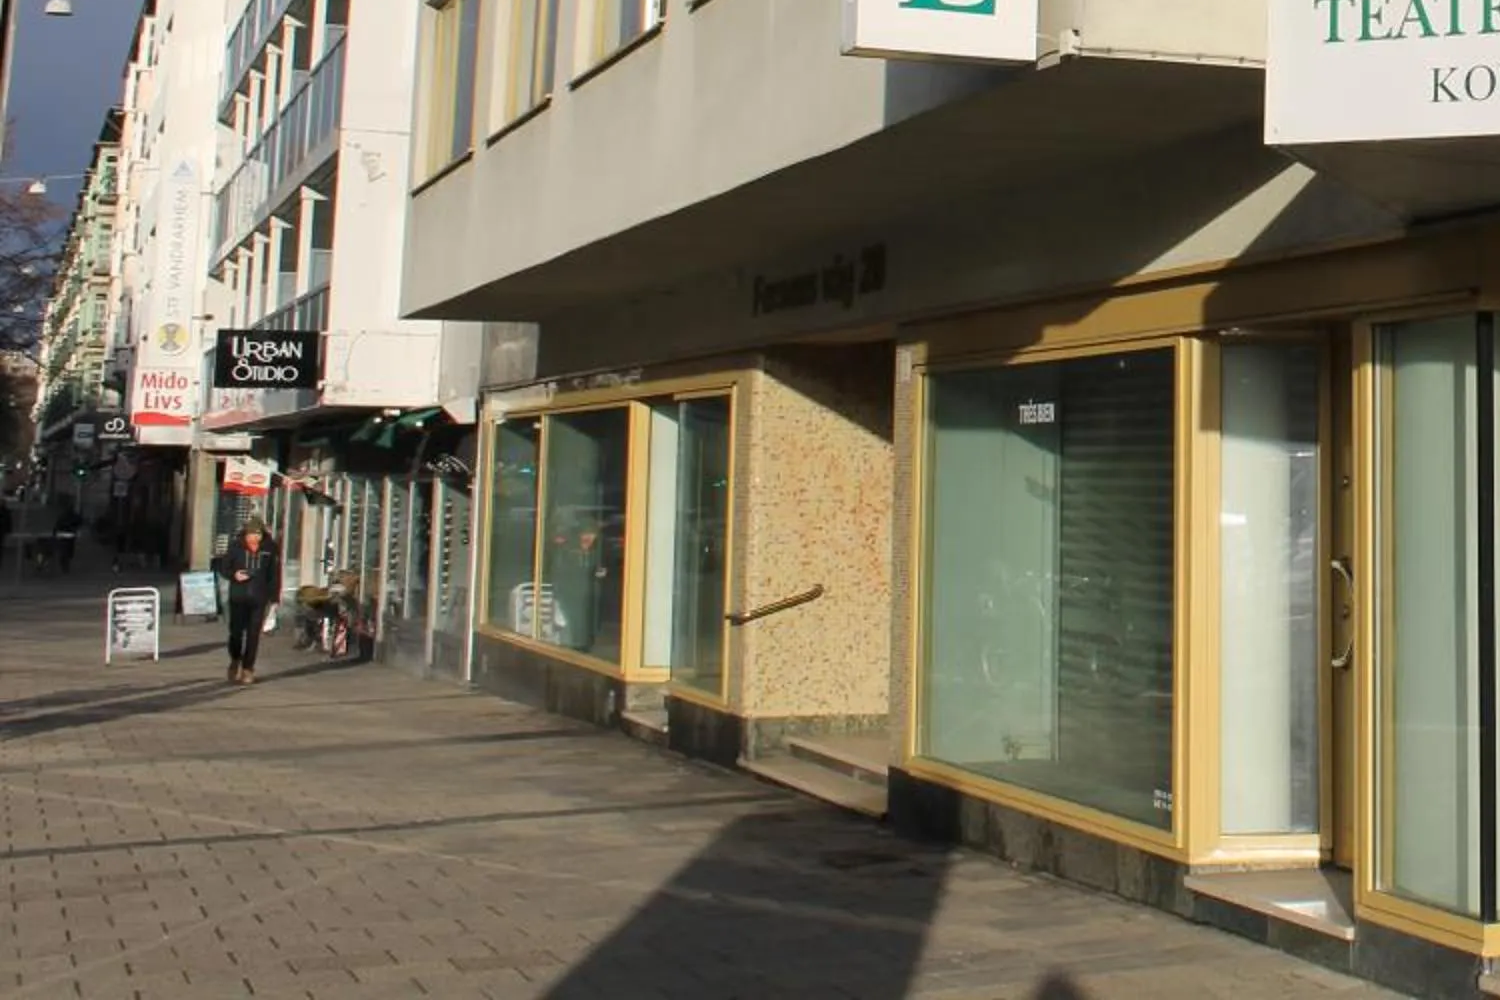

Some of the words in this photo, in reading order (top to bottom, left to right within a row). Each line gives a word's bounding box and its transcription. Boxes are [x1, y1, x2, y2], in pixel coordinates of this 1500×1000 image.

[232, 335, 303, 363] URBAN
[141, 371, 189, 390] Mido
[231, 356, 299, 382] STUDIO
[144, 390, 183, 410] Livs
